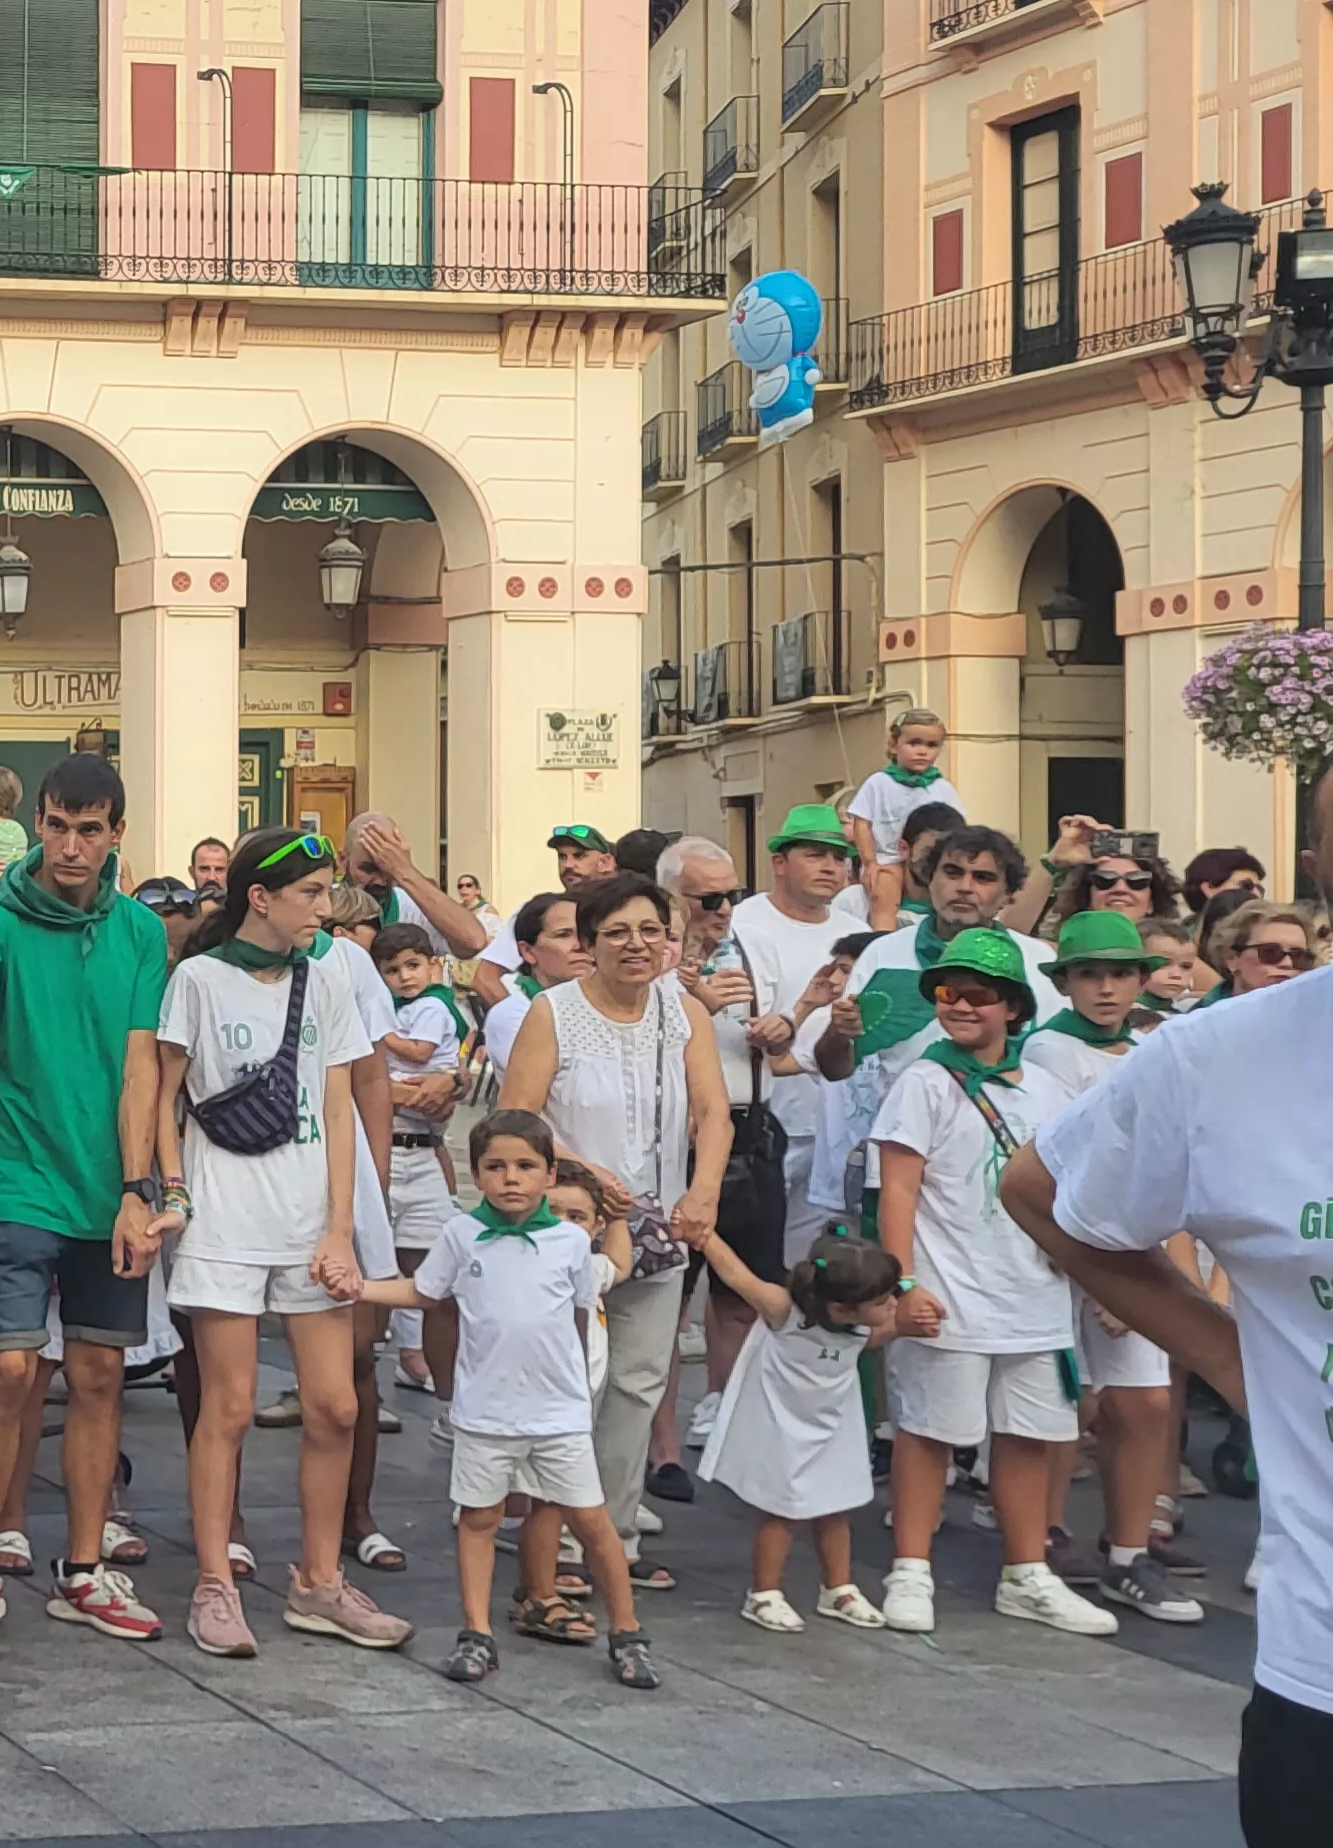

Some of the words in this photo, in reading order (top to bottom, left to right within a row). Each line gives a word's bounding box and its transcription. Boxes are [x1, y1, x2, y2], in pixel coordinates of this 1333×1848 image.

[2, 485, 74, 512] CONFIANZA
[282, 492, 322, 511] desde
[328, 496, 359, 515] 1871
[19, 669, 122, 708] ULTRAMA
[220, 1022, 253, 1050] 10
